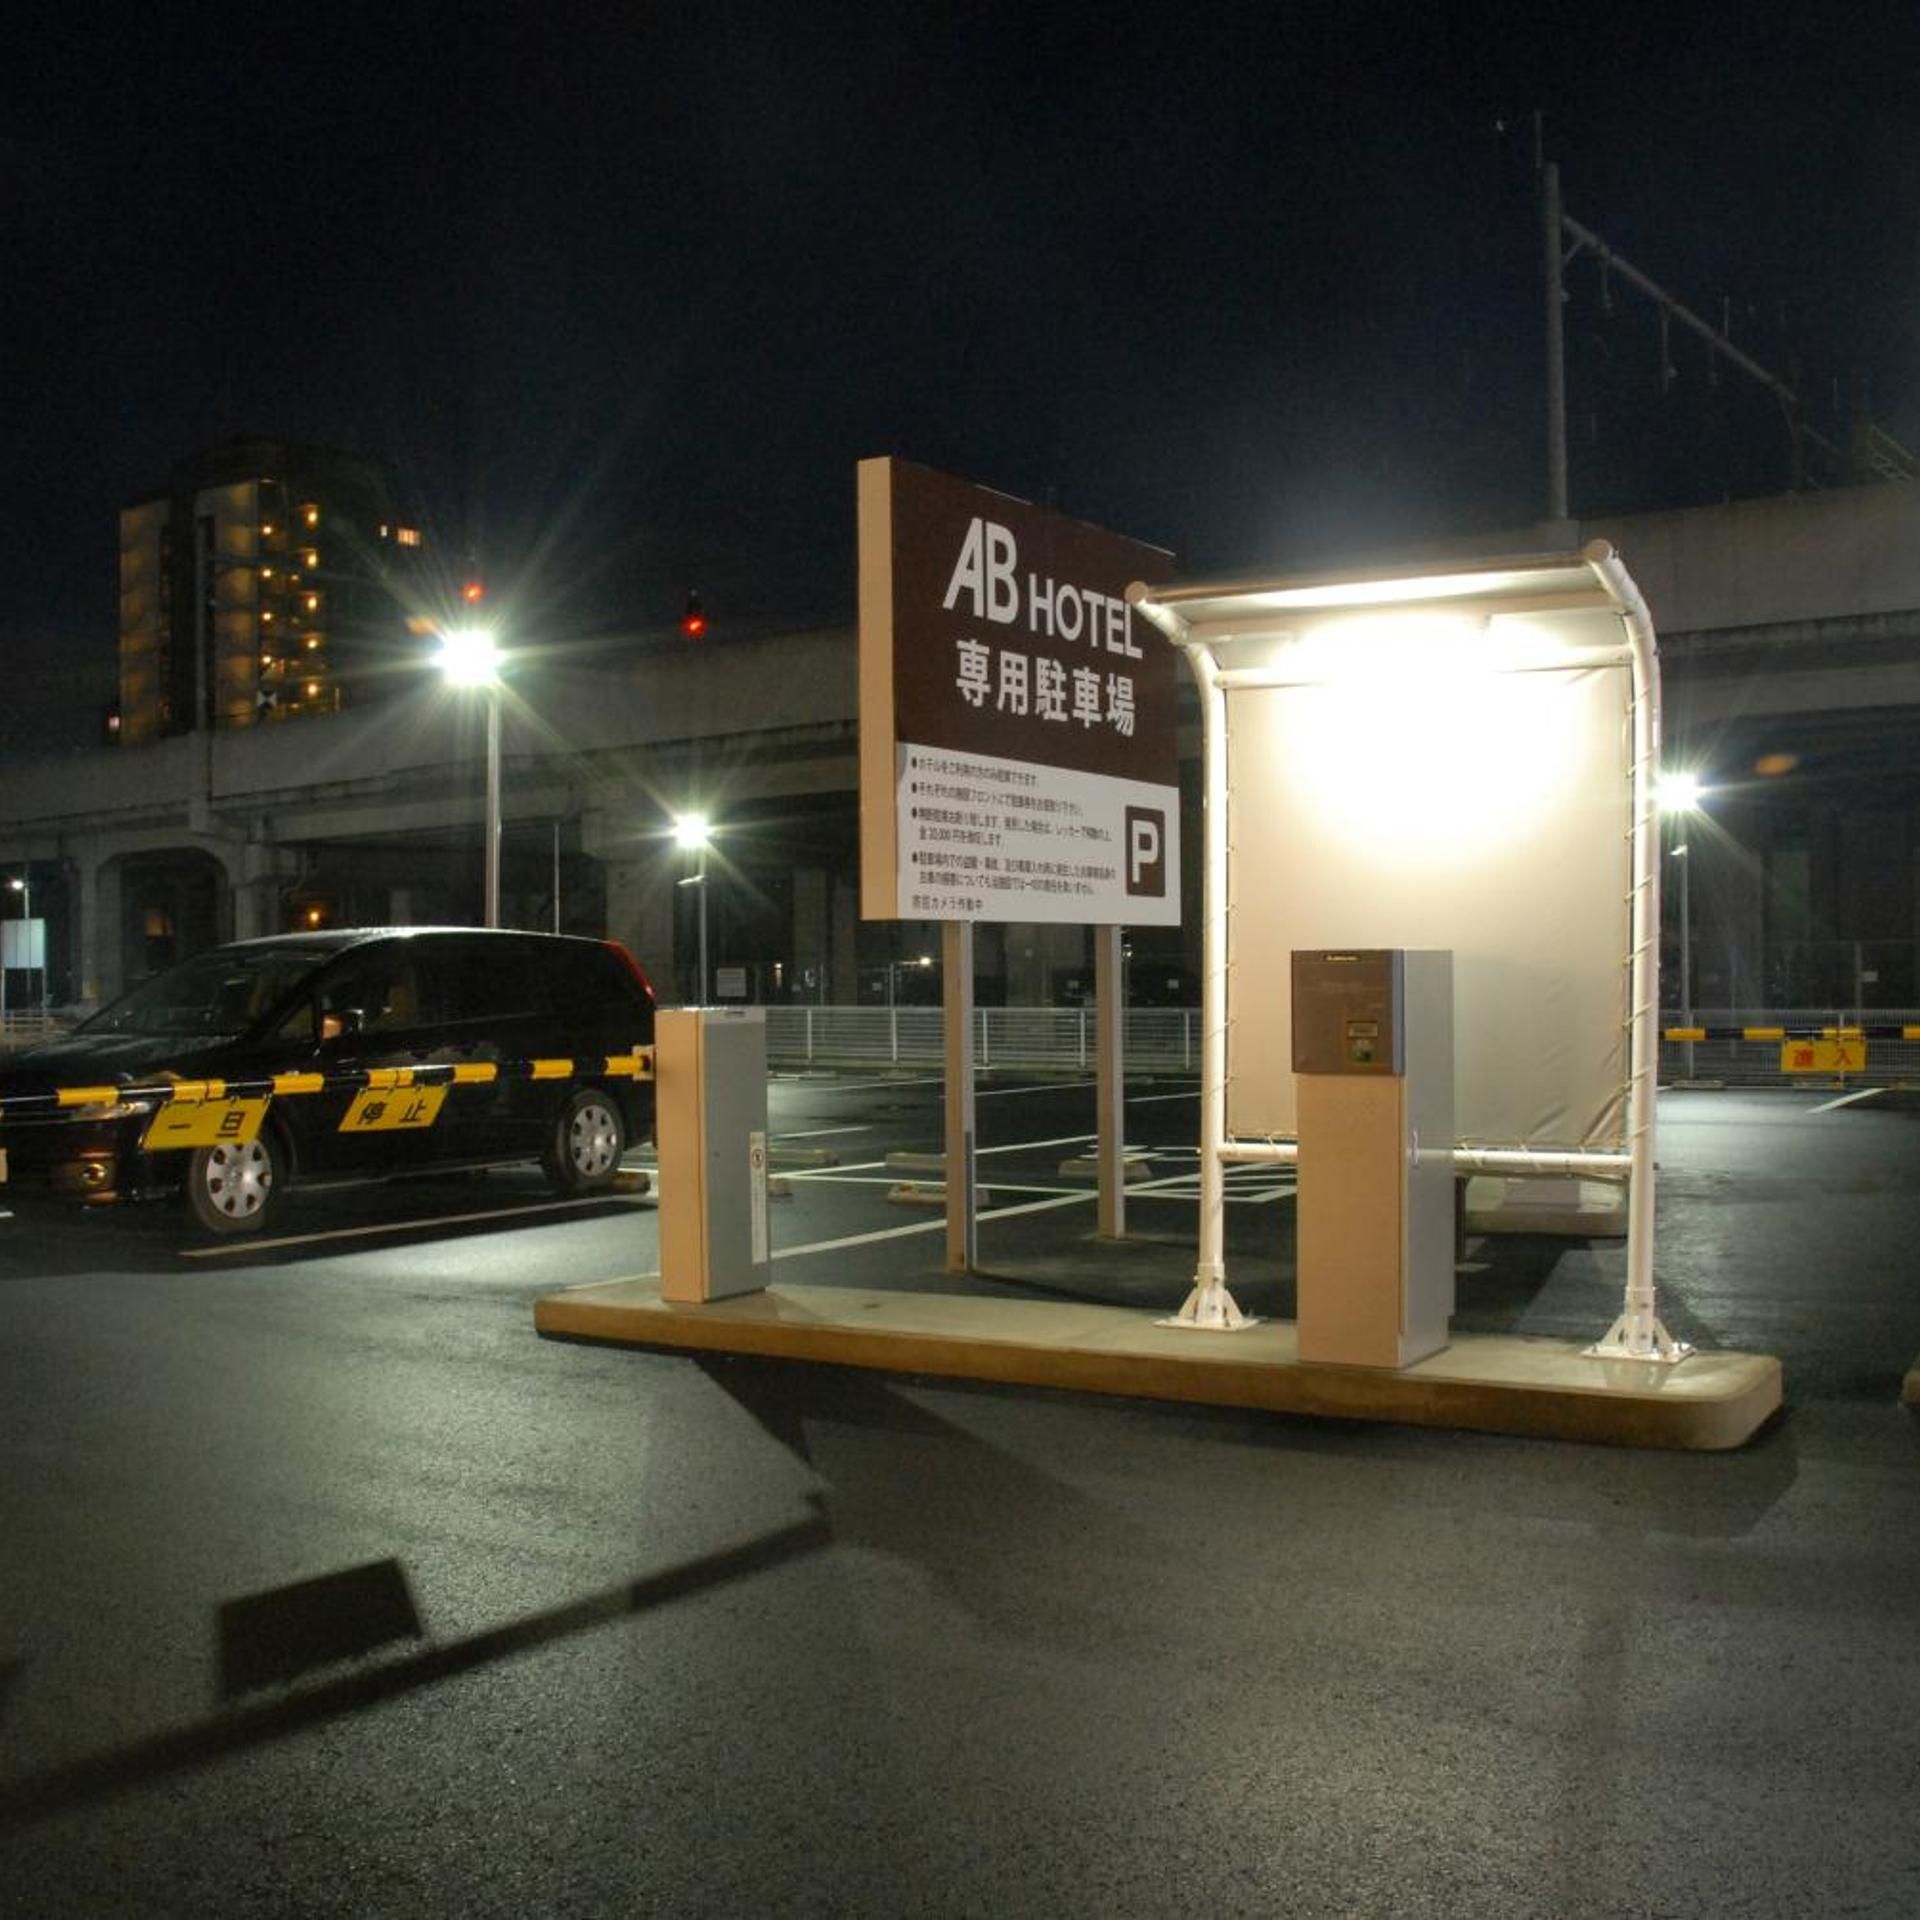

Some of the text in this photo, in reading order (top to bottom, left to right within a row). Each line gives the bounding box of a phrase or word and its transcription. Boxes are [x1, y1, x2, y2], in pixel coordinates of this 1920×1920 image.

[943, 517, 1143, 659] AB HOTEL
[956, 639, 1135, 737] 専用駐車場
[1132, 820, 1159, 884] P
[168, 1110, 245, 1138] 一旦
[357, 1101, 426, 1125] 停止
